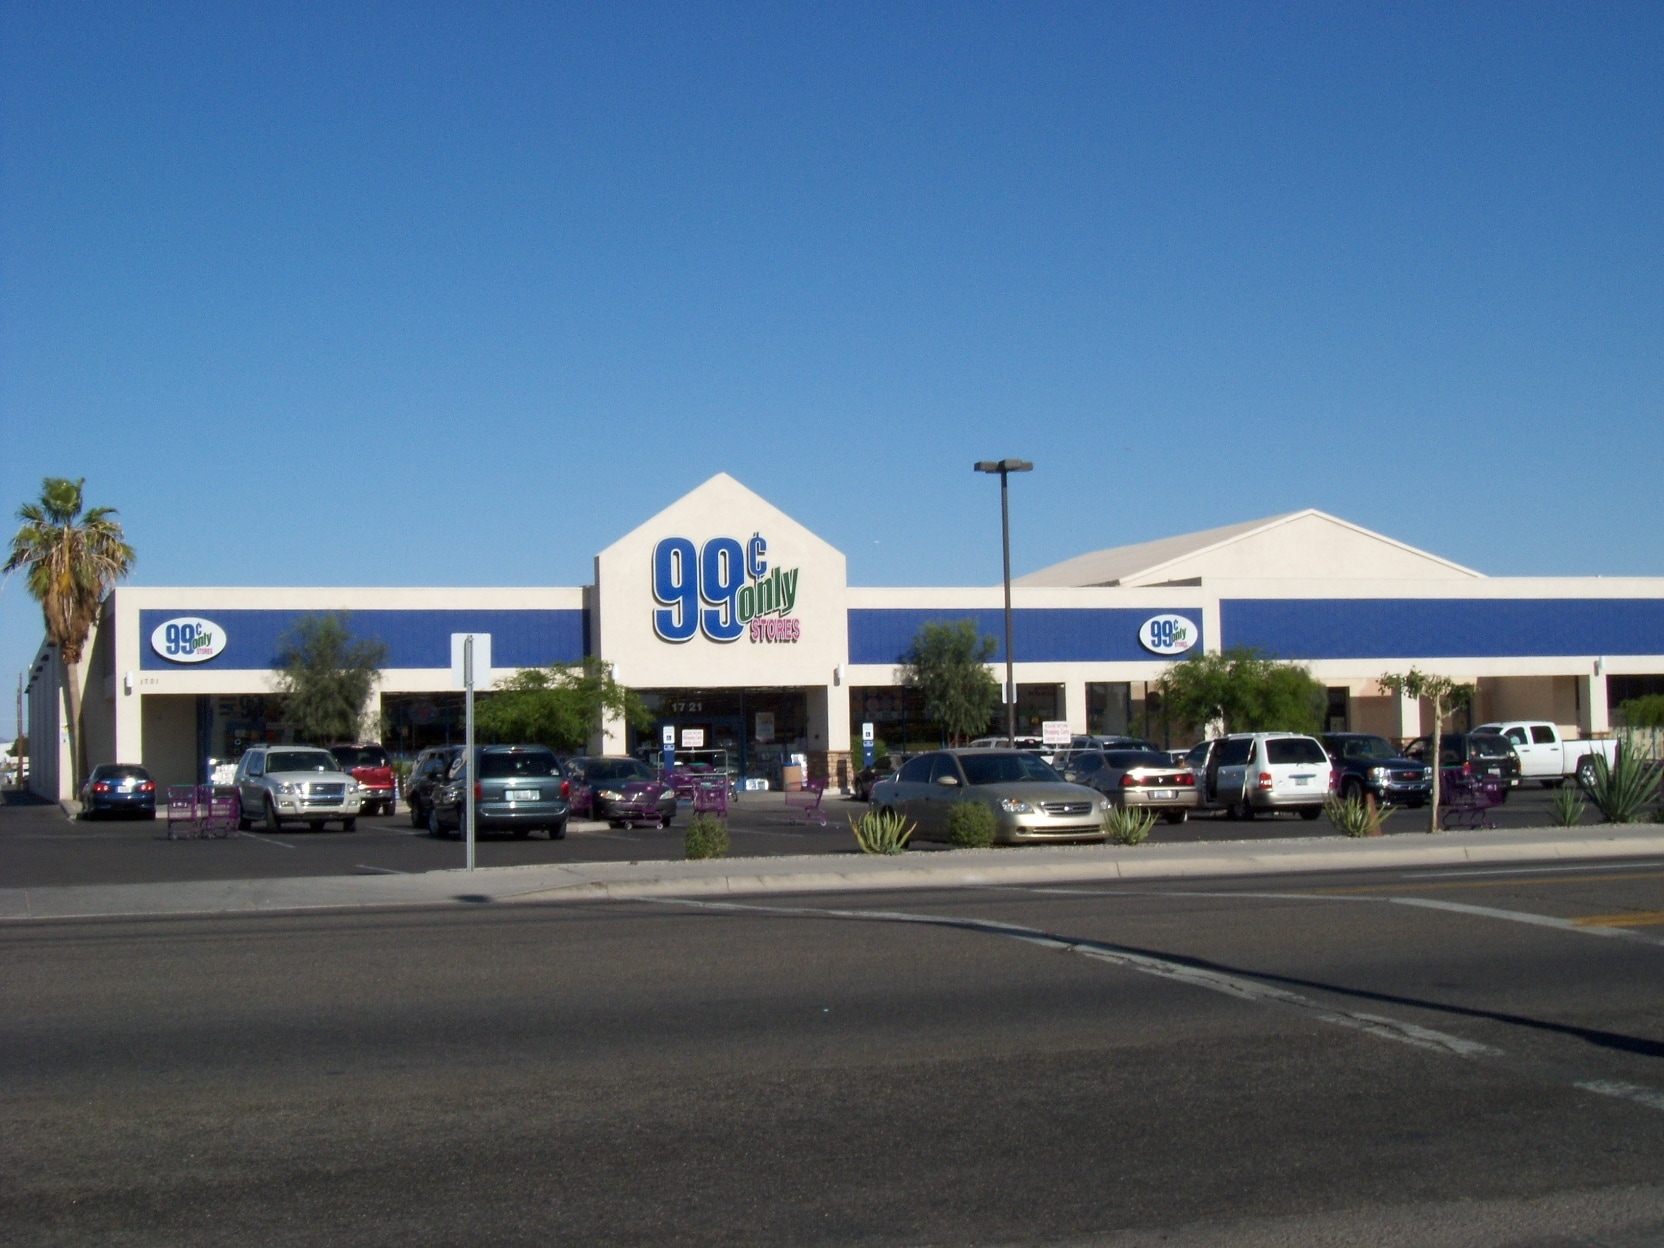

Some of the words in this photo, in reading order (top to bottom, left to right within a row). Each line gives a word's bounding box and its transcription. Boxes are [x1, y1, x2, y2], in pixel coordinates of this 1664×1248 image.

[737, 566, 799, 624] only
[751, 617, 800, 641] STORES
[1171, 628, 1186, 643] only
[192, 632, 212, 650] only
